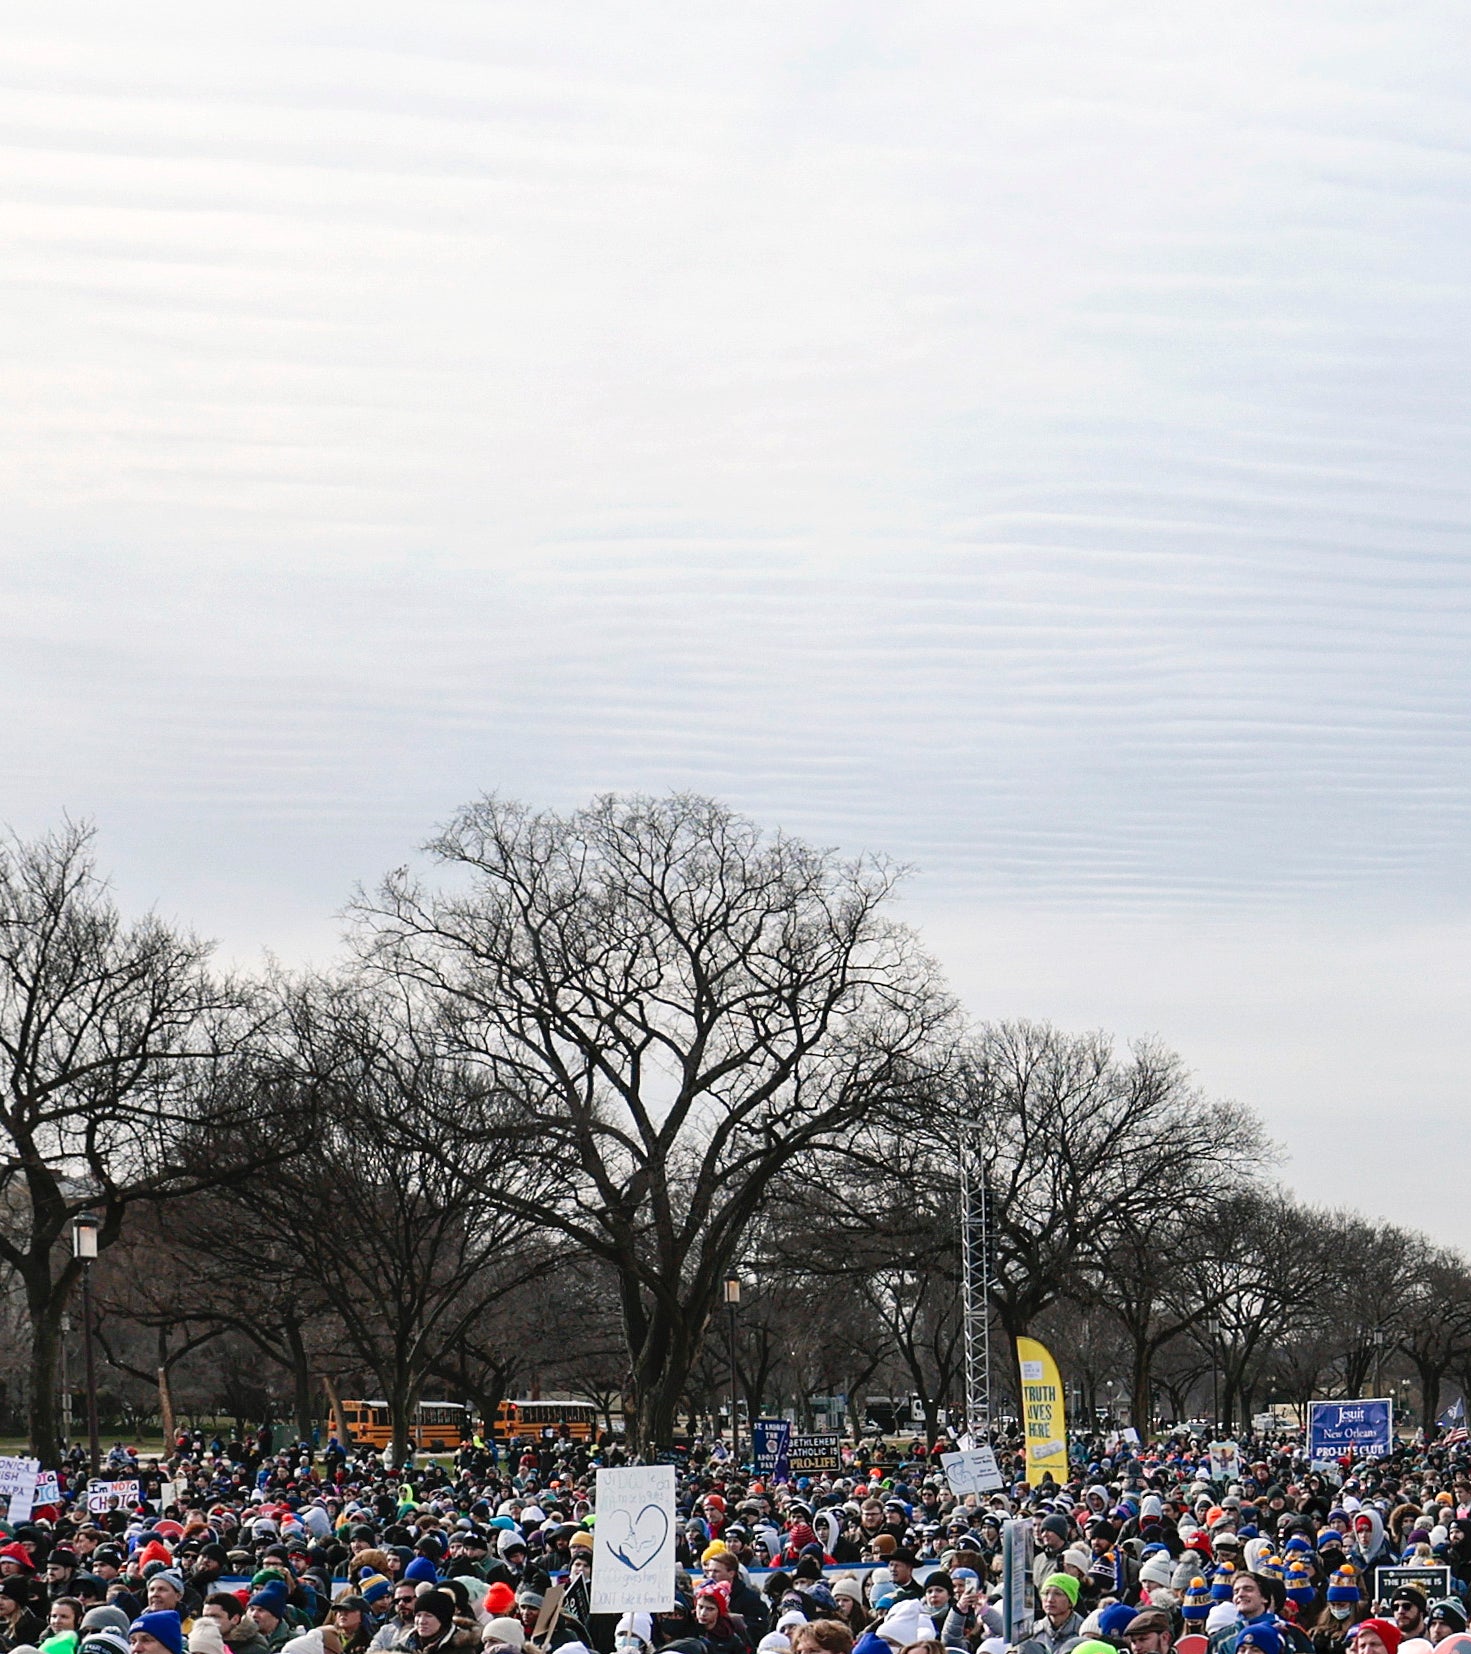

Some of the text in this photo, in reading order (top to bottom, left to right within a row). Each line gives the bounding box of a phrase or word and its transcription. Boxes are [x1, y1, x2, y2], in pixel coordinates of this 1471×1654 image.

[1024, 1386, 1056, 1401] TRUTH
[1335, 1407, 1365, 1428] Jesuit
[1029, 1422, 1051, 1438] HERE
[1323, 1428, 1377, 1439] New Orleans
[789, 1437, 836, 1447] BETHLEHEM
[786, 1447, 838, 1456] CATHOLIC IS
[1360, 1445, 1385, 1455] CLUB
[790, 1458, 836, 1468] PRO-LIFE
[111, 1481, 130, 1492] NOT
[131, 1483, 138, 1491] a
